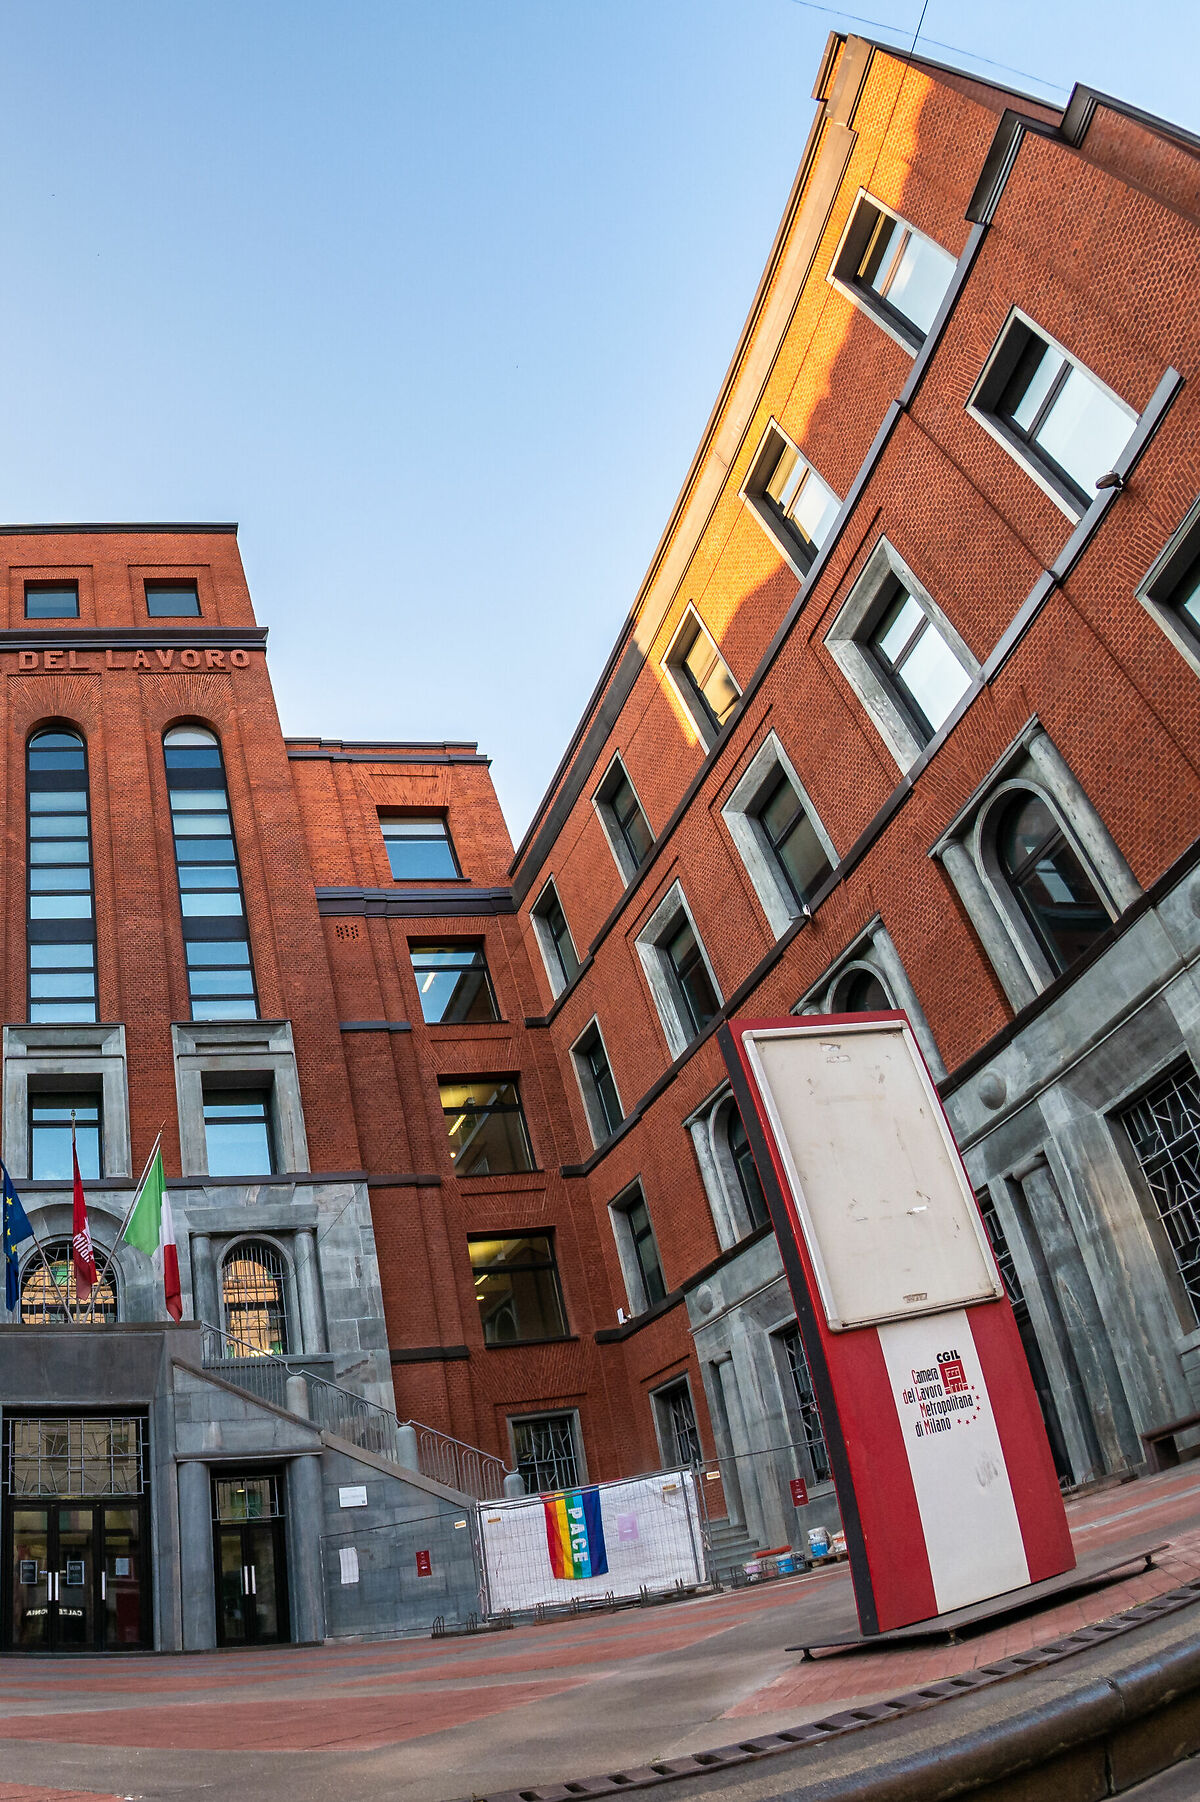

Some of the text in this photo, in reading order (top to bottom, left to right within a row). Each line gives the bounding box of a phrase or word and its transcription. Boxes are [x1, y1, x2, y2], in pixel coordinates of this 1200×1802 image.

[18, 650, 90, 670] DEL
[105, 649, 251, 670] LAVORO
[936, 1349, 961, 1363] CGIL
[911, 1367, 939, 1385] Camera
[902, 1384, 943, 1404] del Lavoro
[919, 1394, 974, 1418] Metropolitana
[915, 1417, 952, 1438] di Milano
[567, 1507, 589, 1563] PACE
